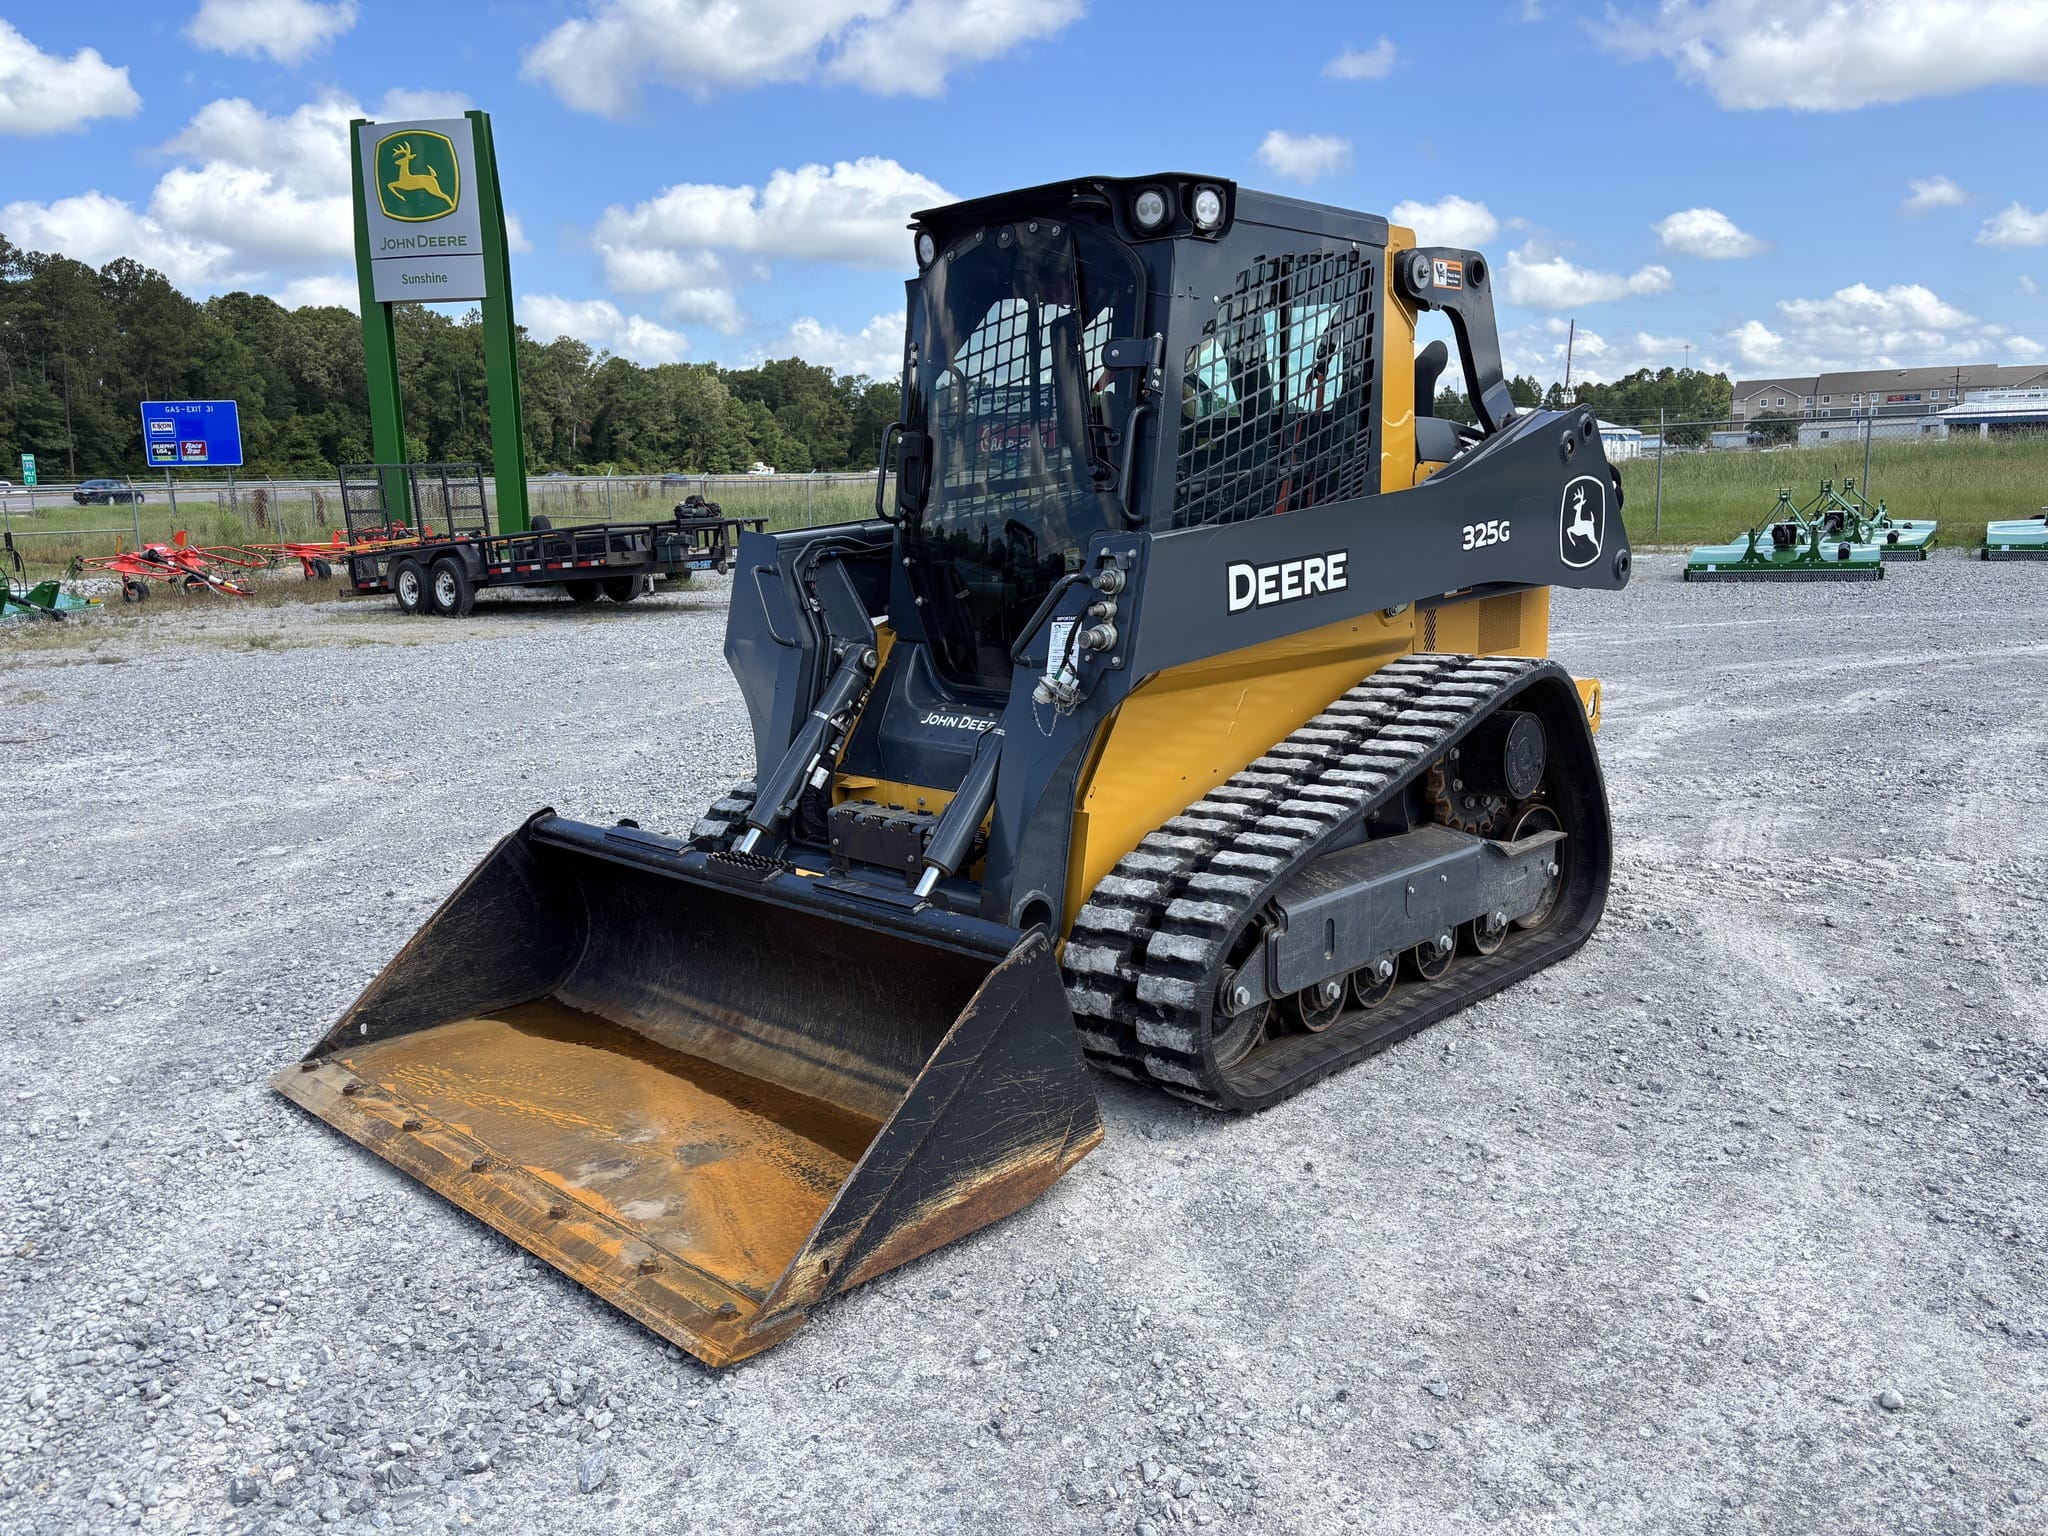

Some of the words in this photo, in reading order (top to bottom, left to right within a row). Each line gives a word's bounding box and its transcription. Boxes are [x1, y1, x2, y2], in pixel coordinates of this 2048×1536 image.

[380, 236, 415, 251] JOHN
[417, 234, 467, 248] DEERE
[401, 272, 448, 285] Sunshine
[205, 405, 214, 413] 31
[1462, 519, 1510, 551] 325G
[1228, 551, 1348, 612] DEERE
[920, 712, 959, 726] JOHN
[959, 716, 997, 731] DEE
